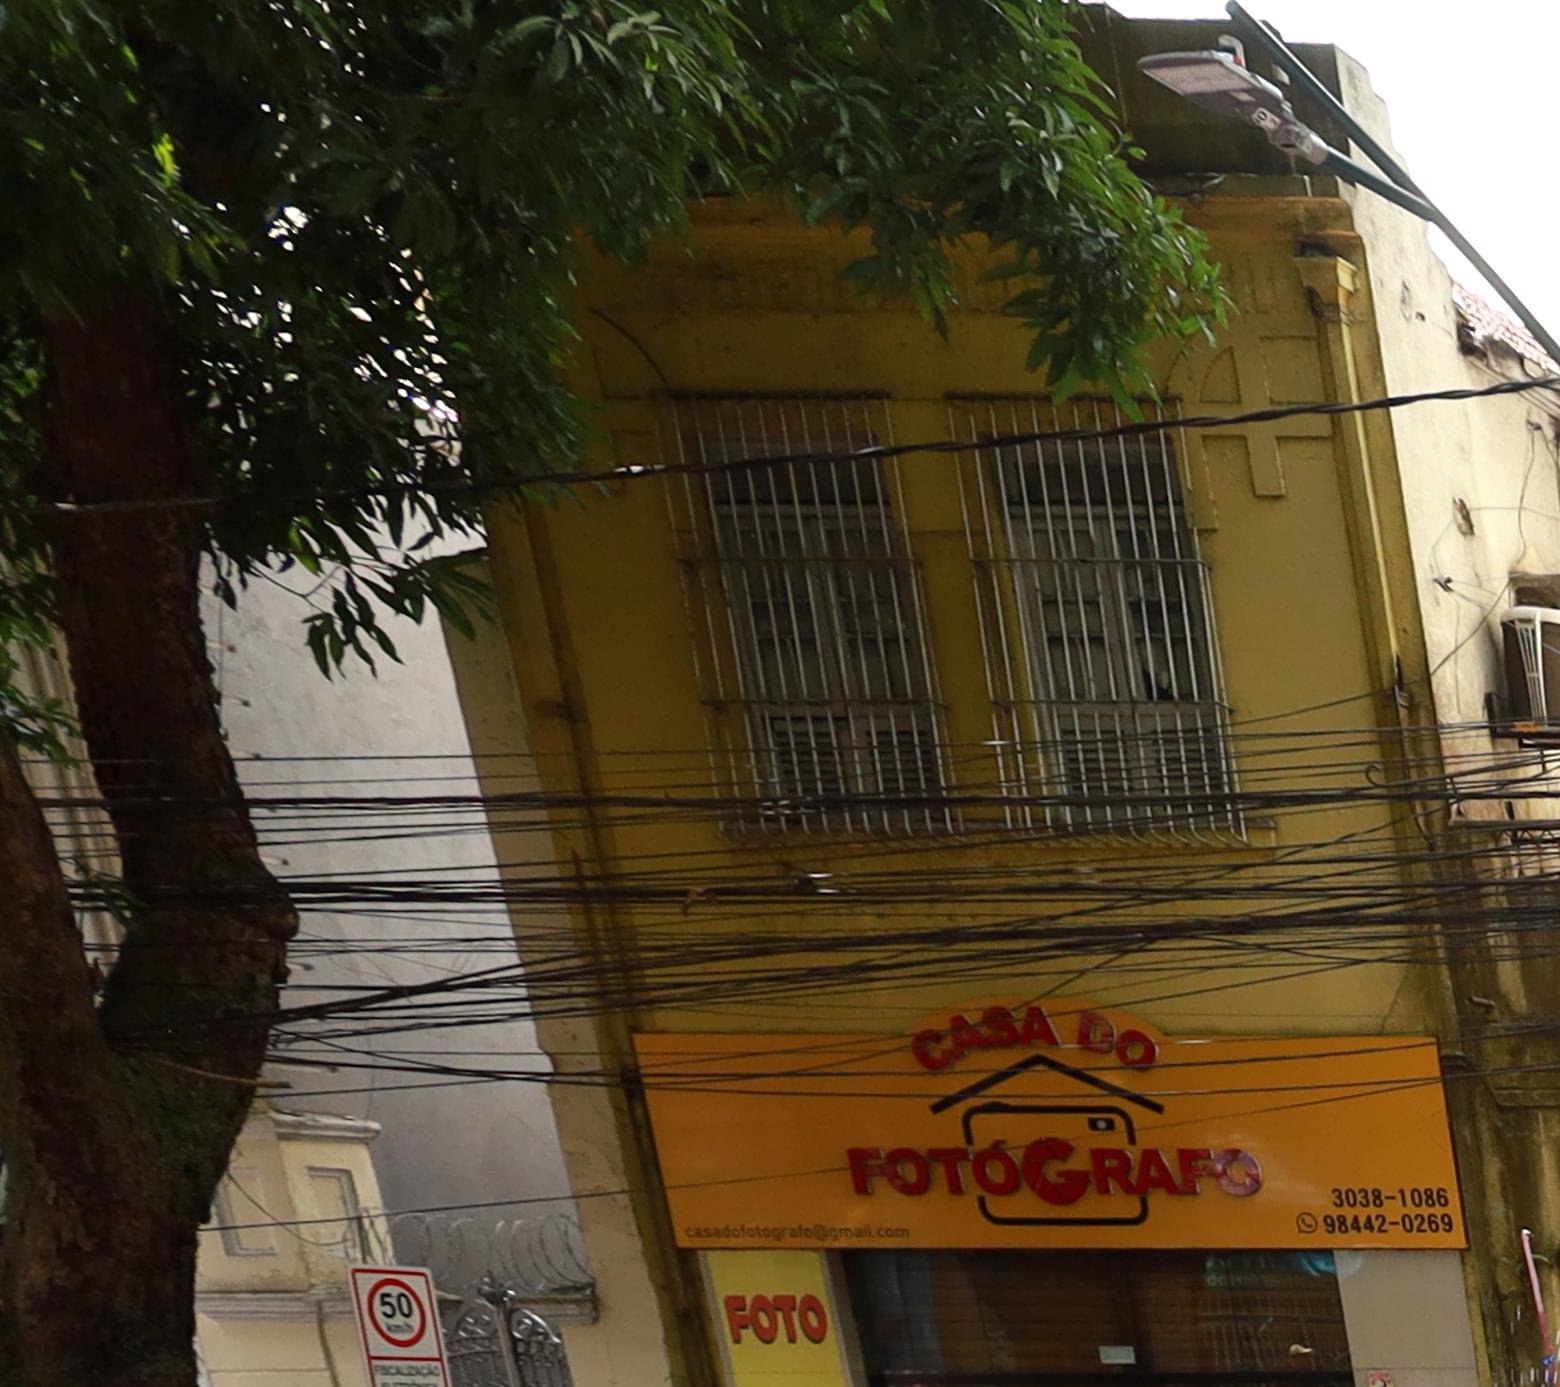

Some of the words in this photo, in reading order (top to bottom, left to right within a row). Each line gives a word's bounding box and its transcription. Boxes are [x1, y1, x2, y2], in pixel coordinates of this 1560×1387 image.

[911, 1005, 1060, 1070] CASA
[1077, 1009, 1159, 1068] DO
[846, 1136, 1263, 1206] FOTÓGRAFO
[1331, 1187, 1450, 1209] 3038-1086
[684, 1223, 910, 1241] casadofotografo@gmail.com
[1323, 1213, 1454, 1234] 98442-0269
[379, 1292, 413, 1318] 50
[724, 1294, 828, 1344] FOTO
